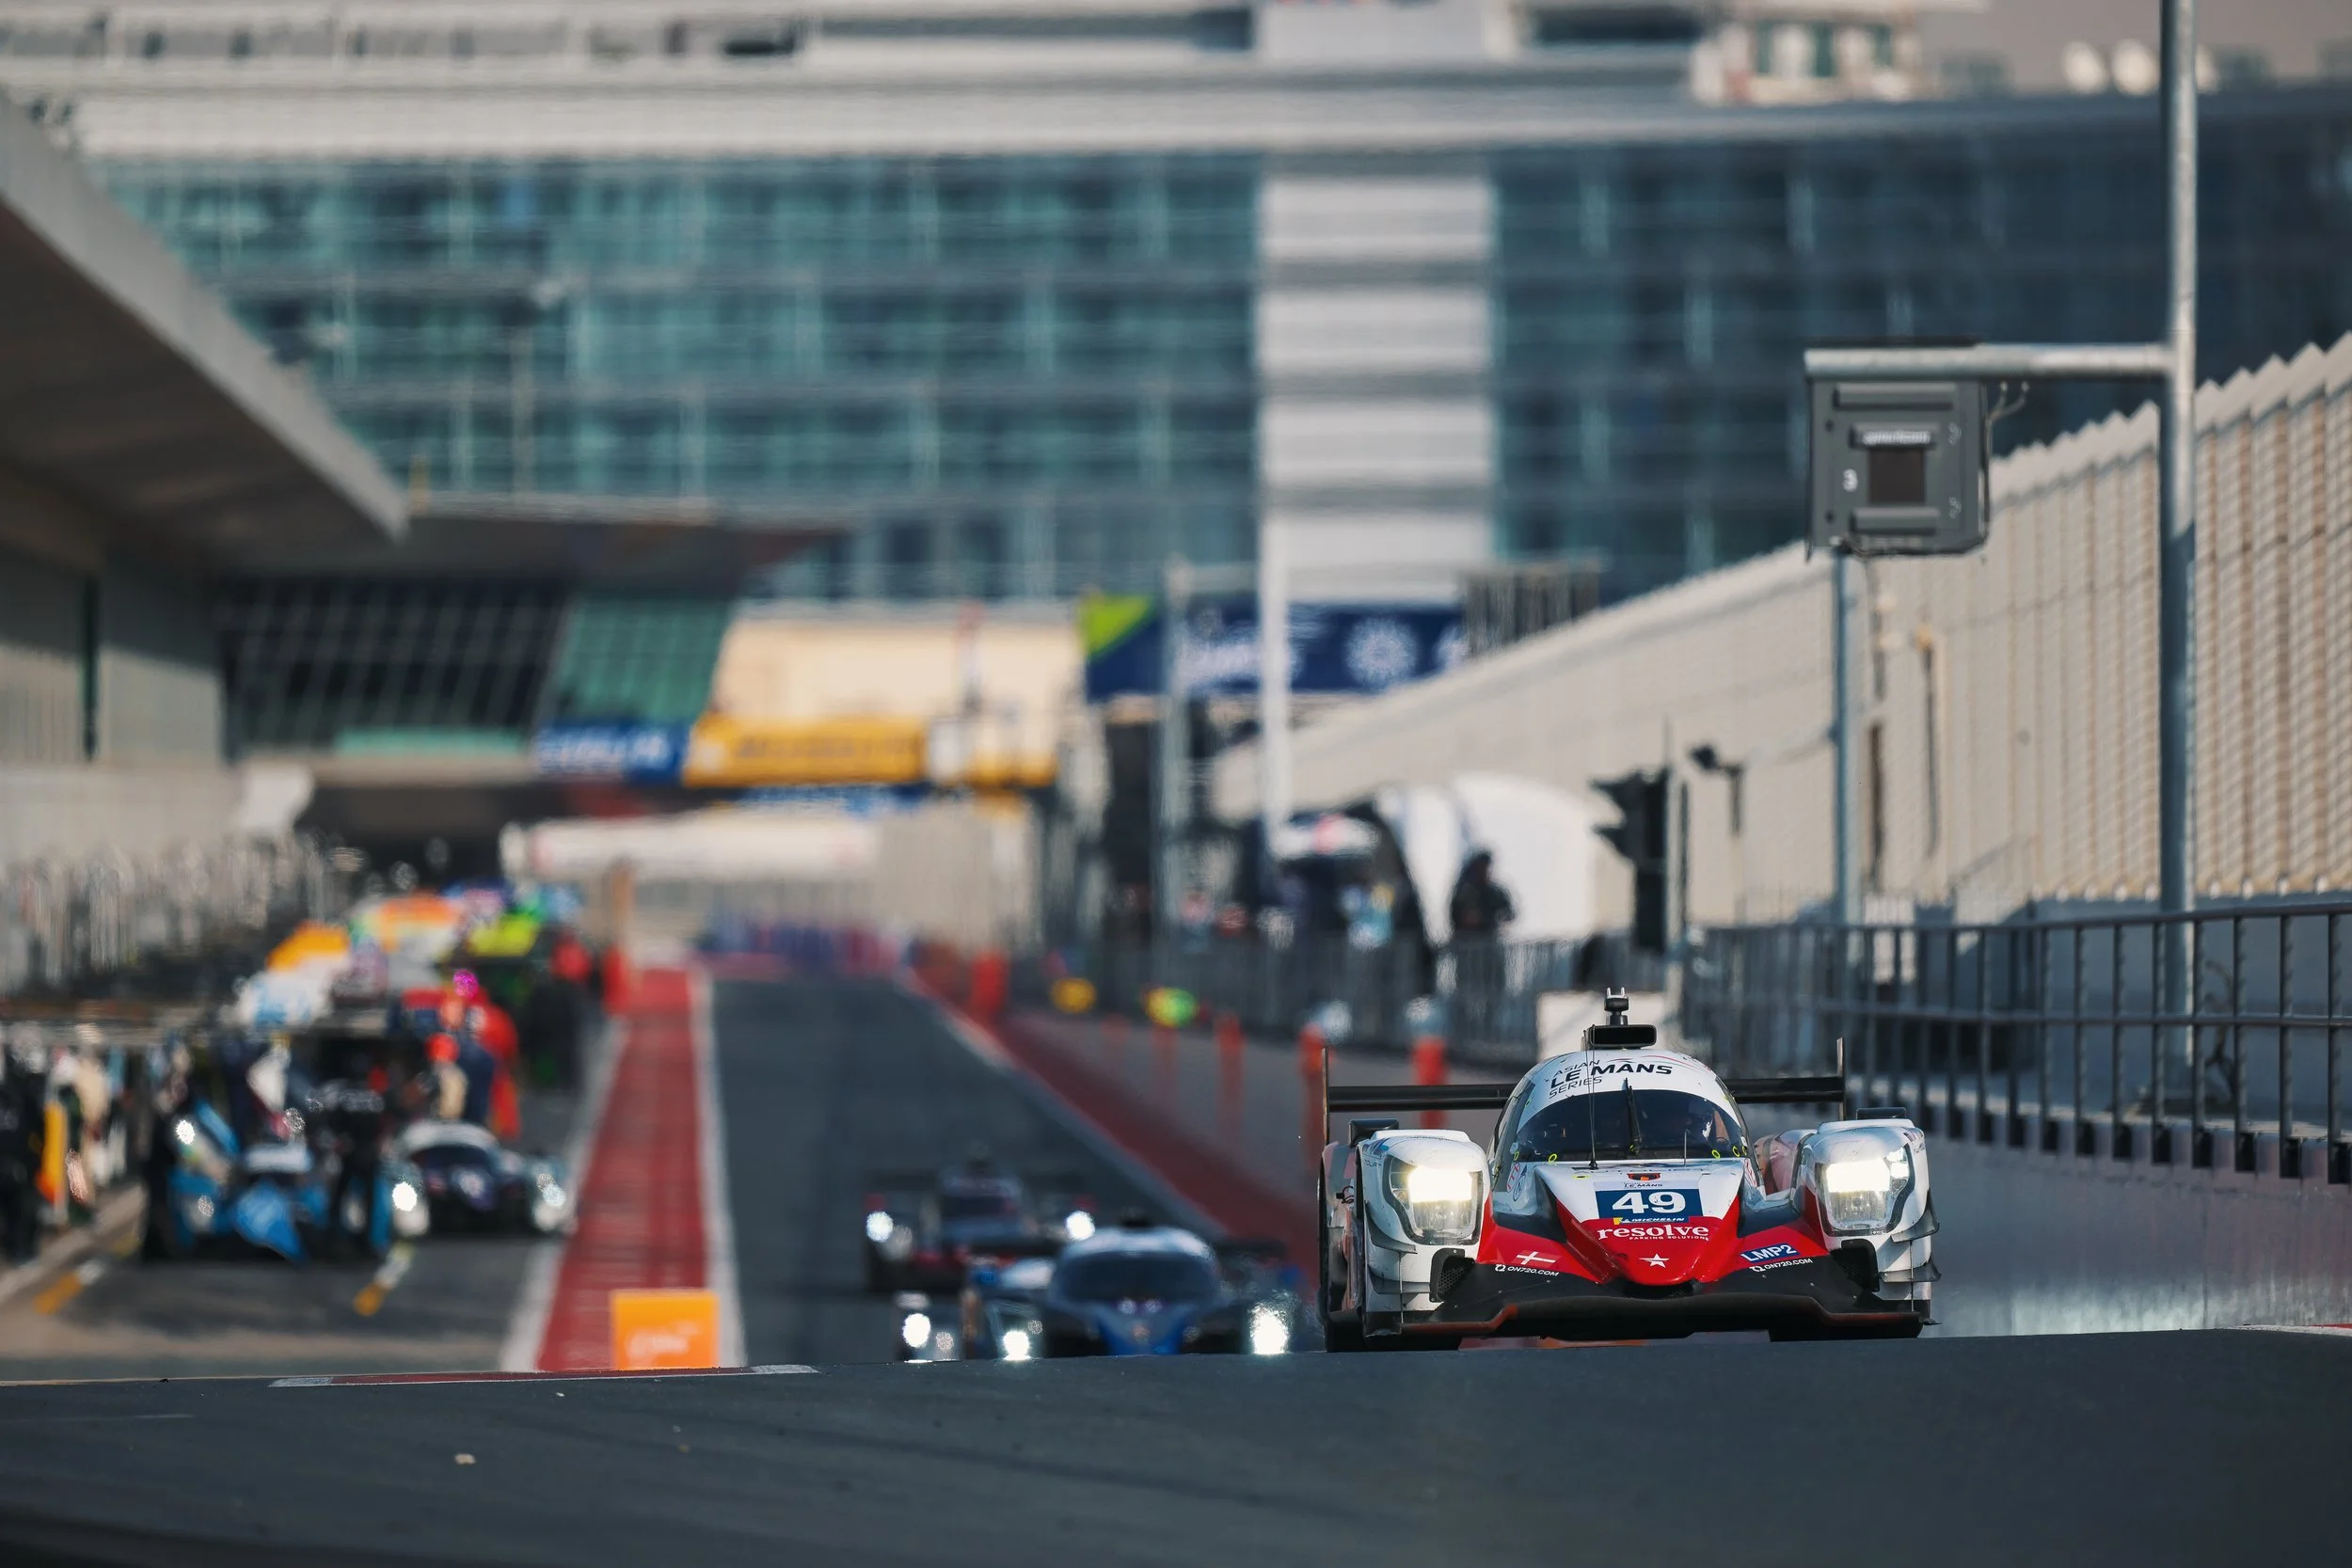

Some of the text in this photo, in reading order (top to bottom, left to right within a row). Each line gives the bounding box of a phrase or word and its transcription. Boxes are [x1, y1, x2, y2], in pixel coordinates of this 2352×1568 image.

[1550, 1063, 1673, 1089] LE MANS
[1554, 1059, 1600, 1077] ASIAN
[1549, 1075, 1603, 1100] SERIES
[1612, 1191, 1686, 1213] 49
[1597, 1224, 1709, 1240] resolve
[1740, 1244, 1797, 1261] LMP2
